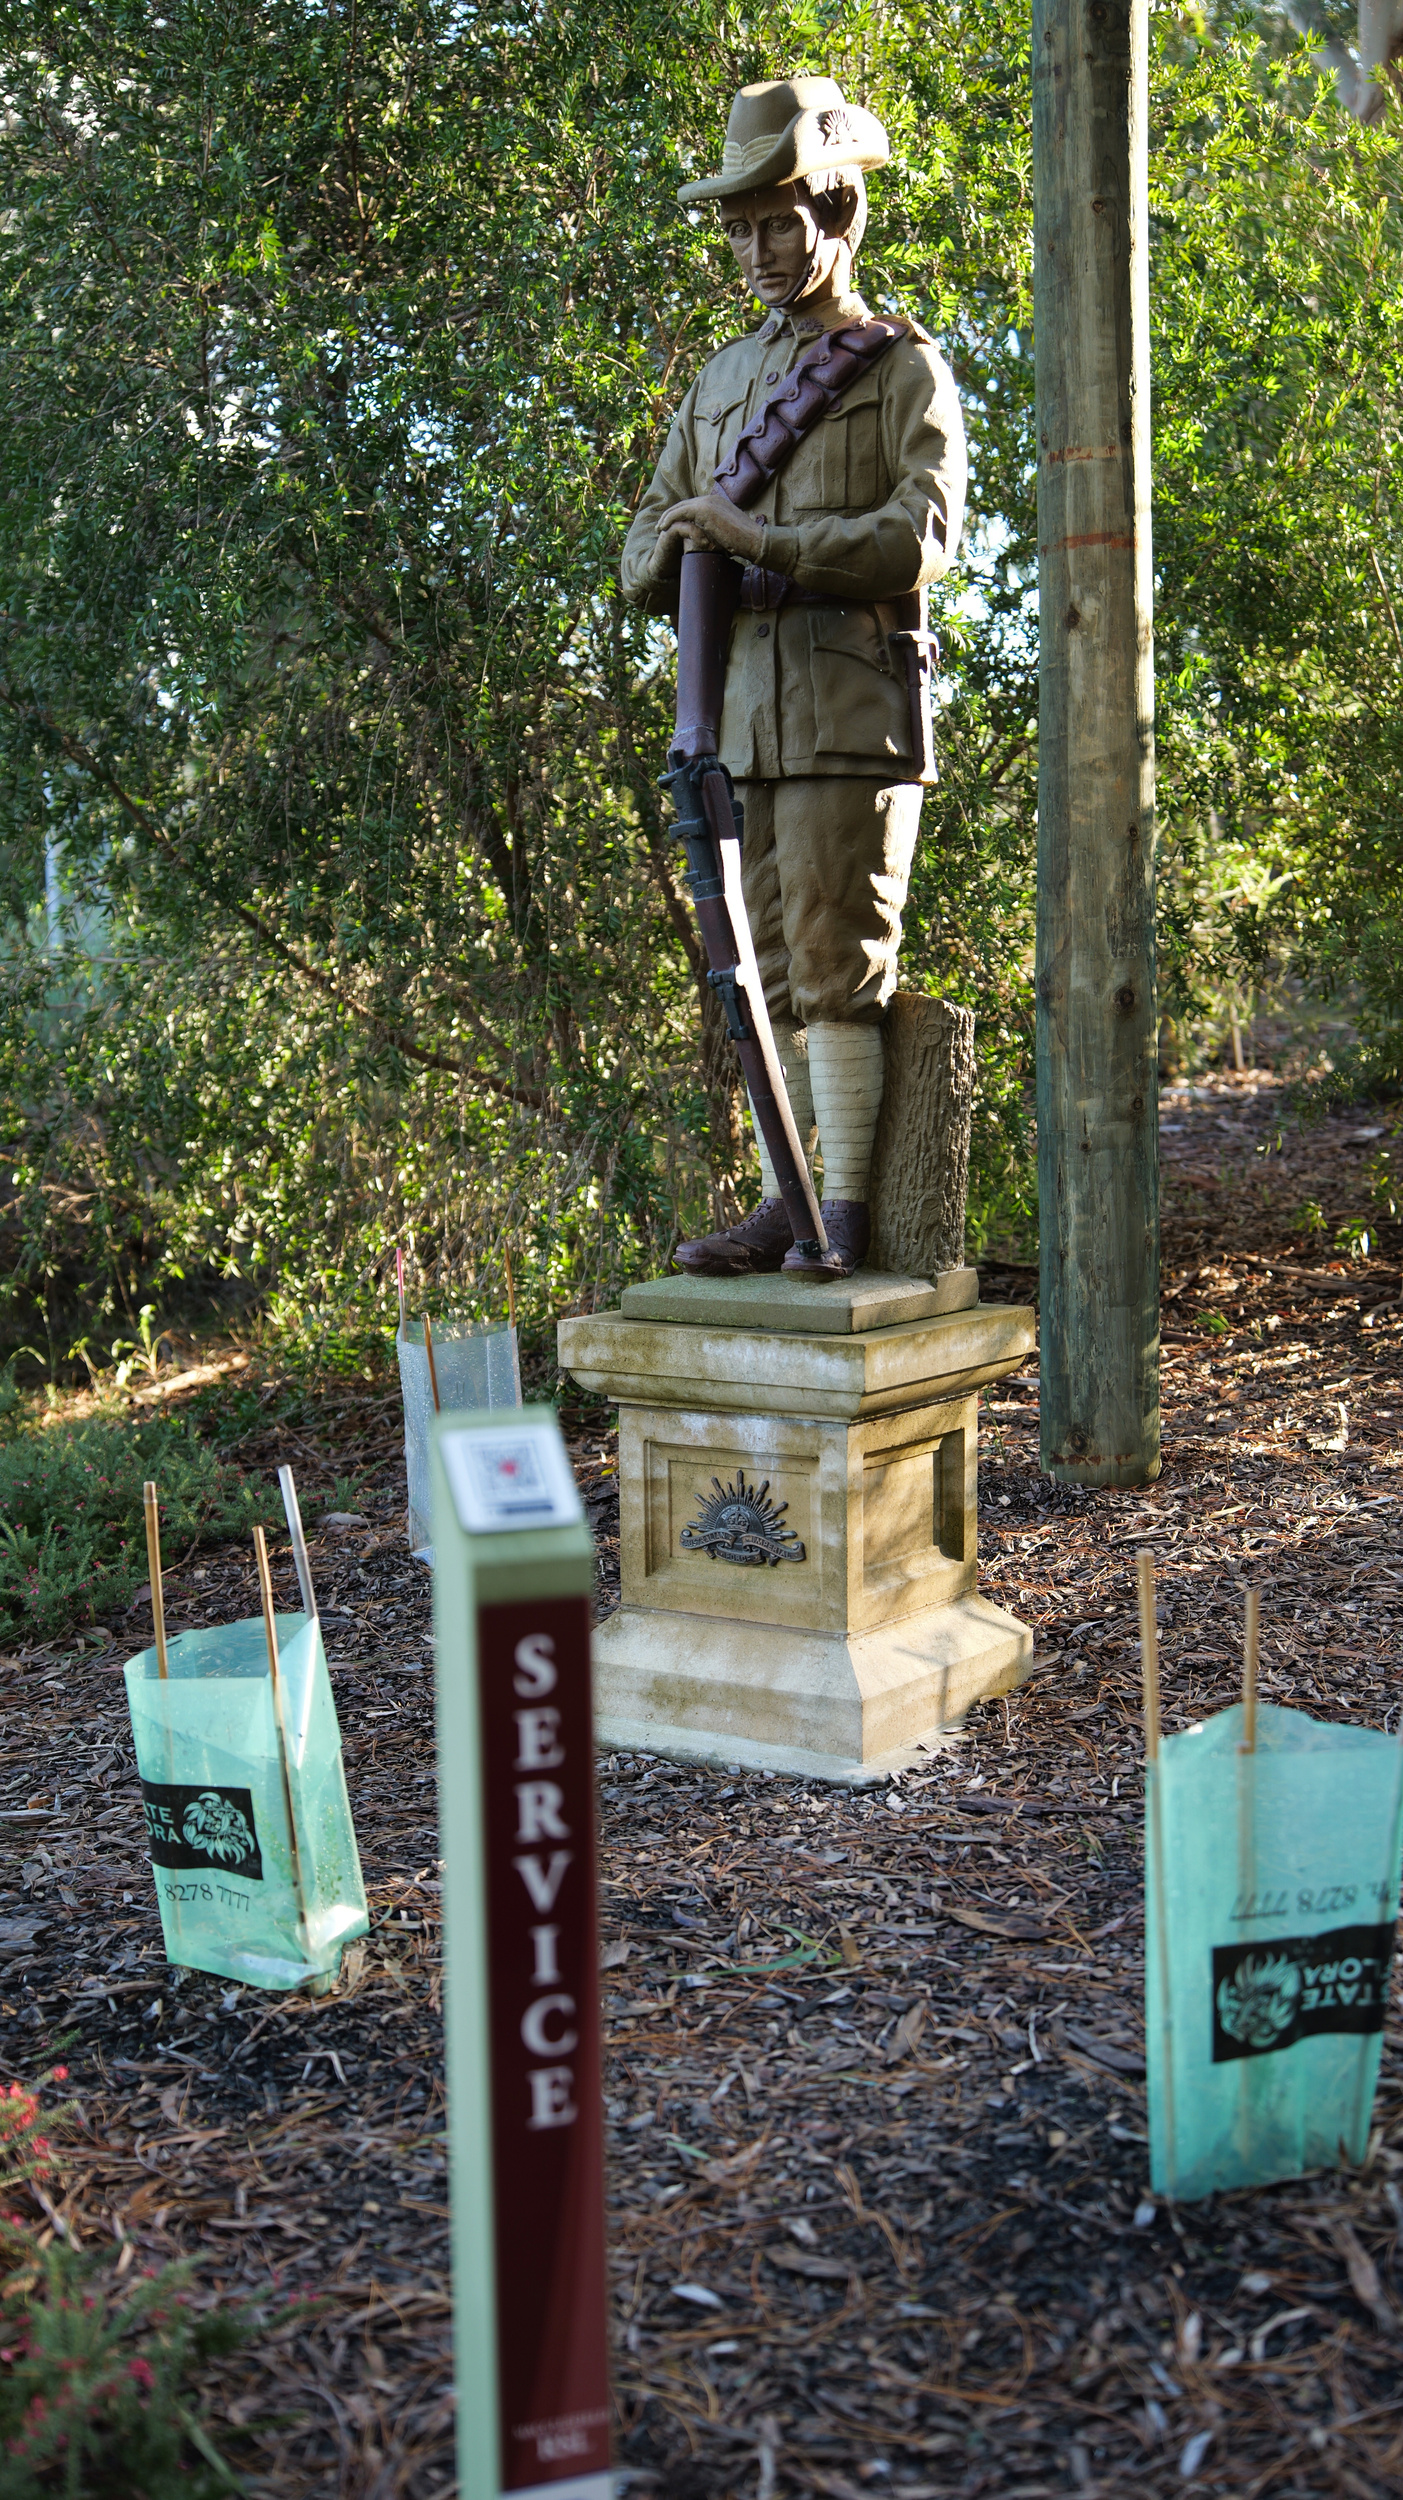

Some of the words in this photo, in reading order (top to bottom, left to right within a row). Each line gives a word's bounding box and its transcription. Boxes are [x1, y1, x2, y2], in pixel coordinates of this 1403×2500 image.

[751, 1536, 792, 1559] IMPERIAL
[164, 1882, 213, 1902] 8278
[216, 1885, 250, 1912] 7777
[512, 1631, 579, 2132] SERVICE
[1229, 1889, 1288, 1922] 7777
[1296, 1884, 1359, 1916] 8278
